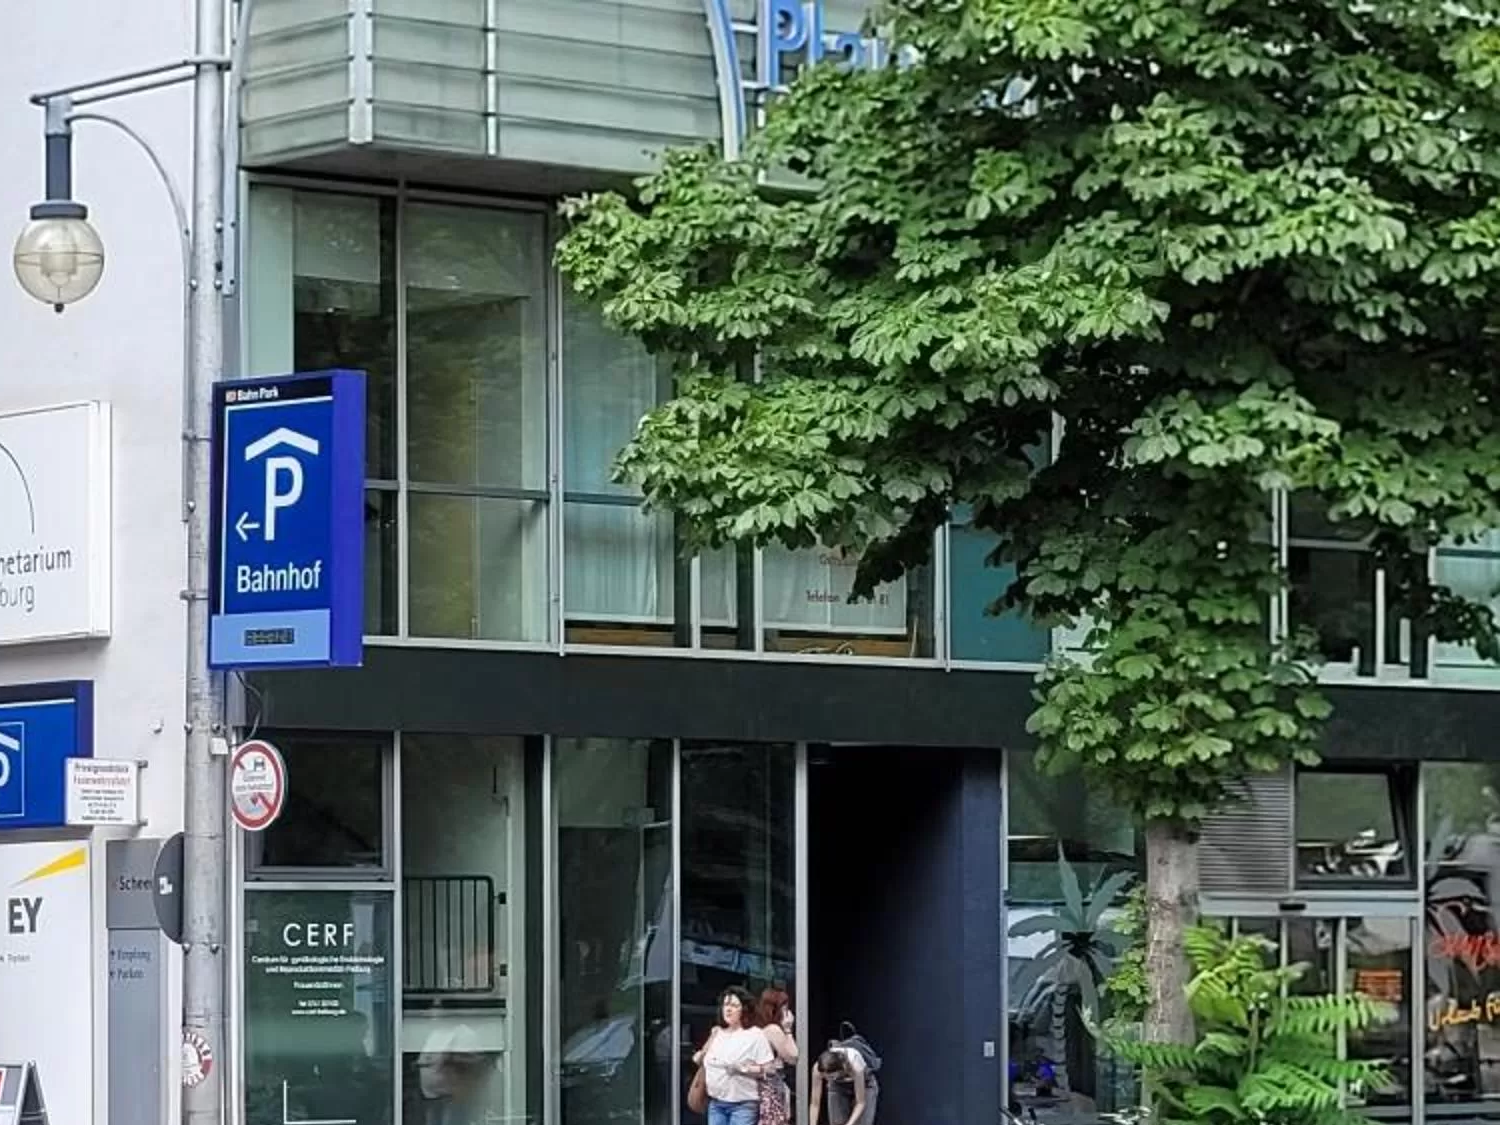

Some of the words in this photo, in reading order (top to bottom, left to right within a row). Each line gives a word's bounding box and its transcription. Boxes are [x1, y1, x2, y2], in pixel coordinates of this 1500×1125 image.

[237, 388, 260, 401] Bahn
[260, 386, 279, 399] Park
[264, 456, 304, 541] P
[237, 560, 323, 593] Bahnhof
[119, 875, 153, 891] Schee
[8, 897, 43, 934] EY
[283, 922, 355, 947] CERF
